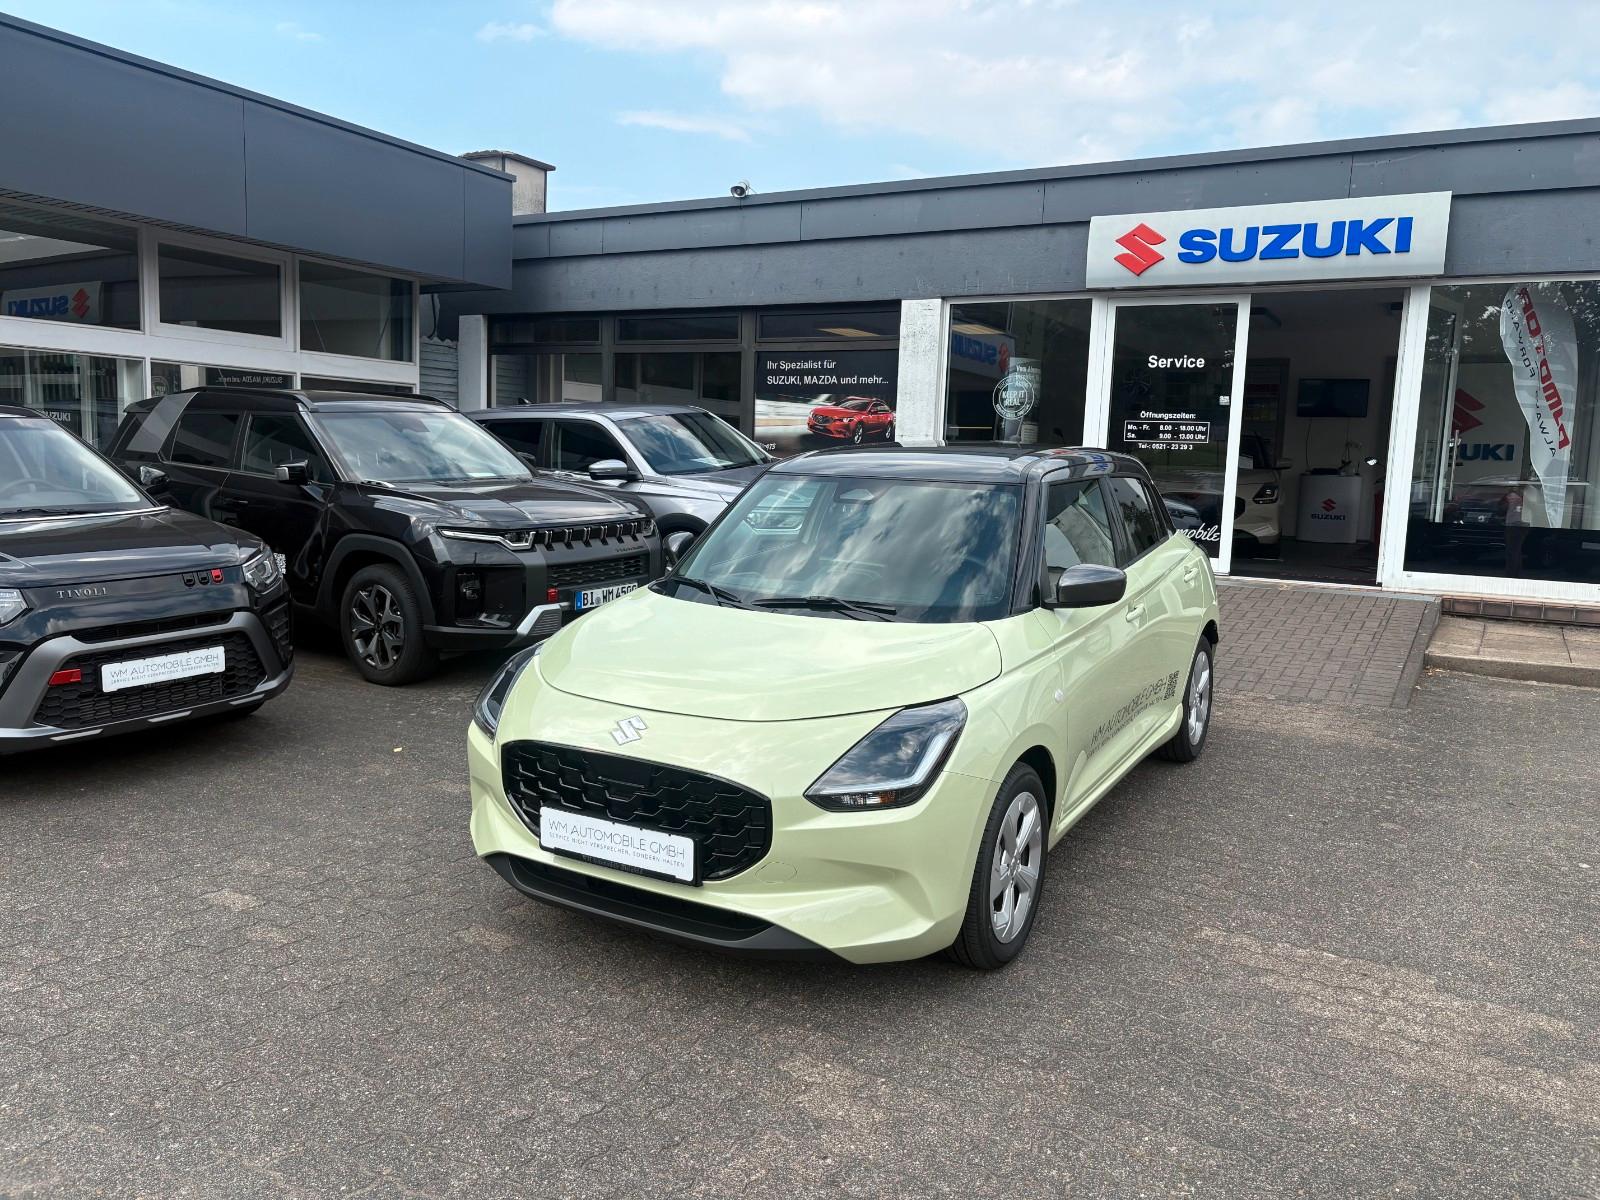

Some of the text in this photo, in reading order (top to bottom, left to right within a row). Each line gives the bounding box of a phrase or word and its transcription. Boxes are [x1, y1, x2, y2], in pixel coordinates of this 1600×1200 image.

[1178, 217, 1414, 264] SUZUKI
[767, 360, 836, 371] Ihr Spezialist für
[1148, 355, 1205, 368] Service
[767, 375, 889, 386] SUZUKI, MAZDA und mehr...
[1140, 410, 1197, 420] Öffnungszeiten:
[1311, 513, 1346, 521] SUZUKI
[57, 588, 107, 598] TIVOLI
[582, 592, 595, 606] BI
[602, 588, 614, 603] WM
[110, 653, 219, 678] WM AUTOMOBILE GMBH
[549, 818, 685, 860] WM AUTOMOBILE GMBH
[571, 838, 588, 846] NICHT
[662, 858, 685, 868] HALTEN
